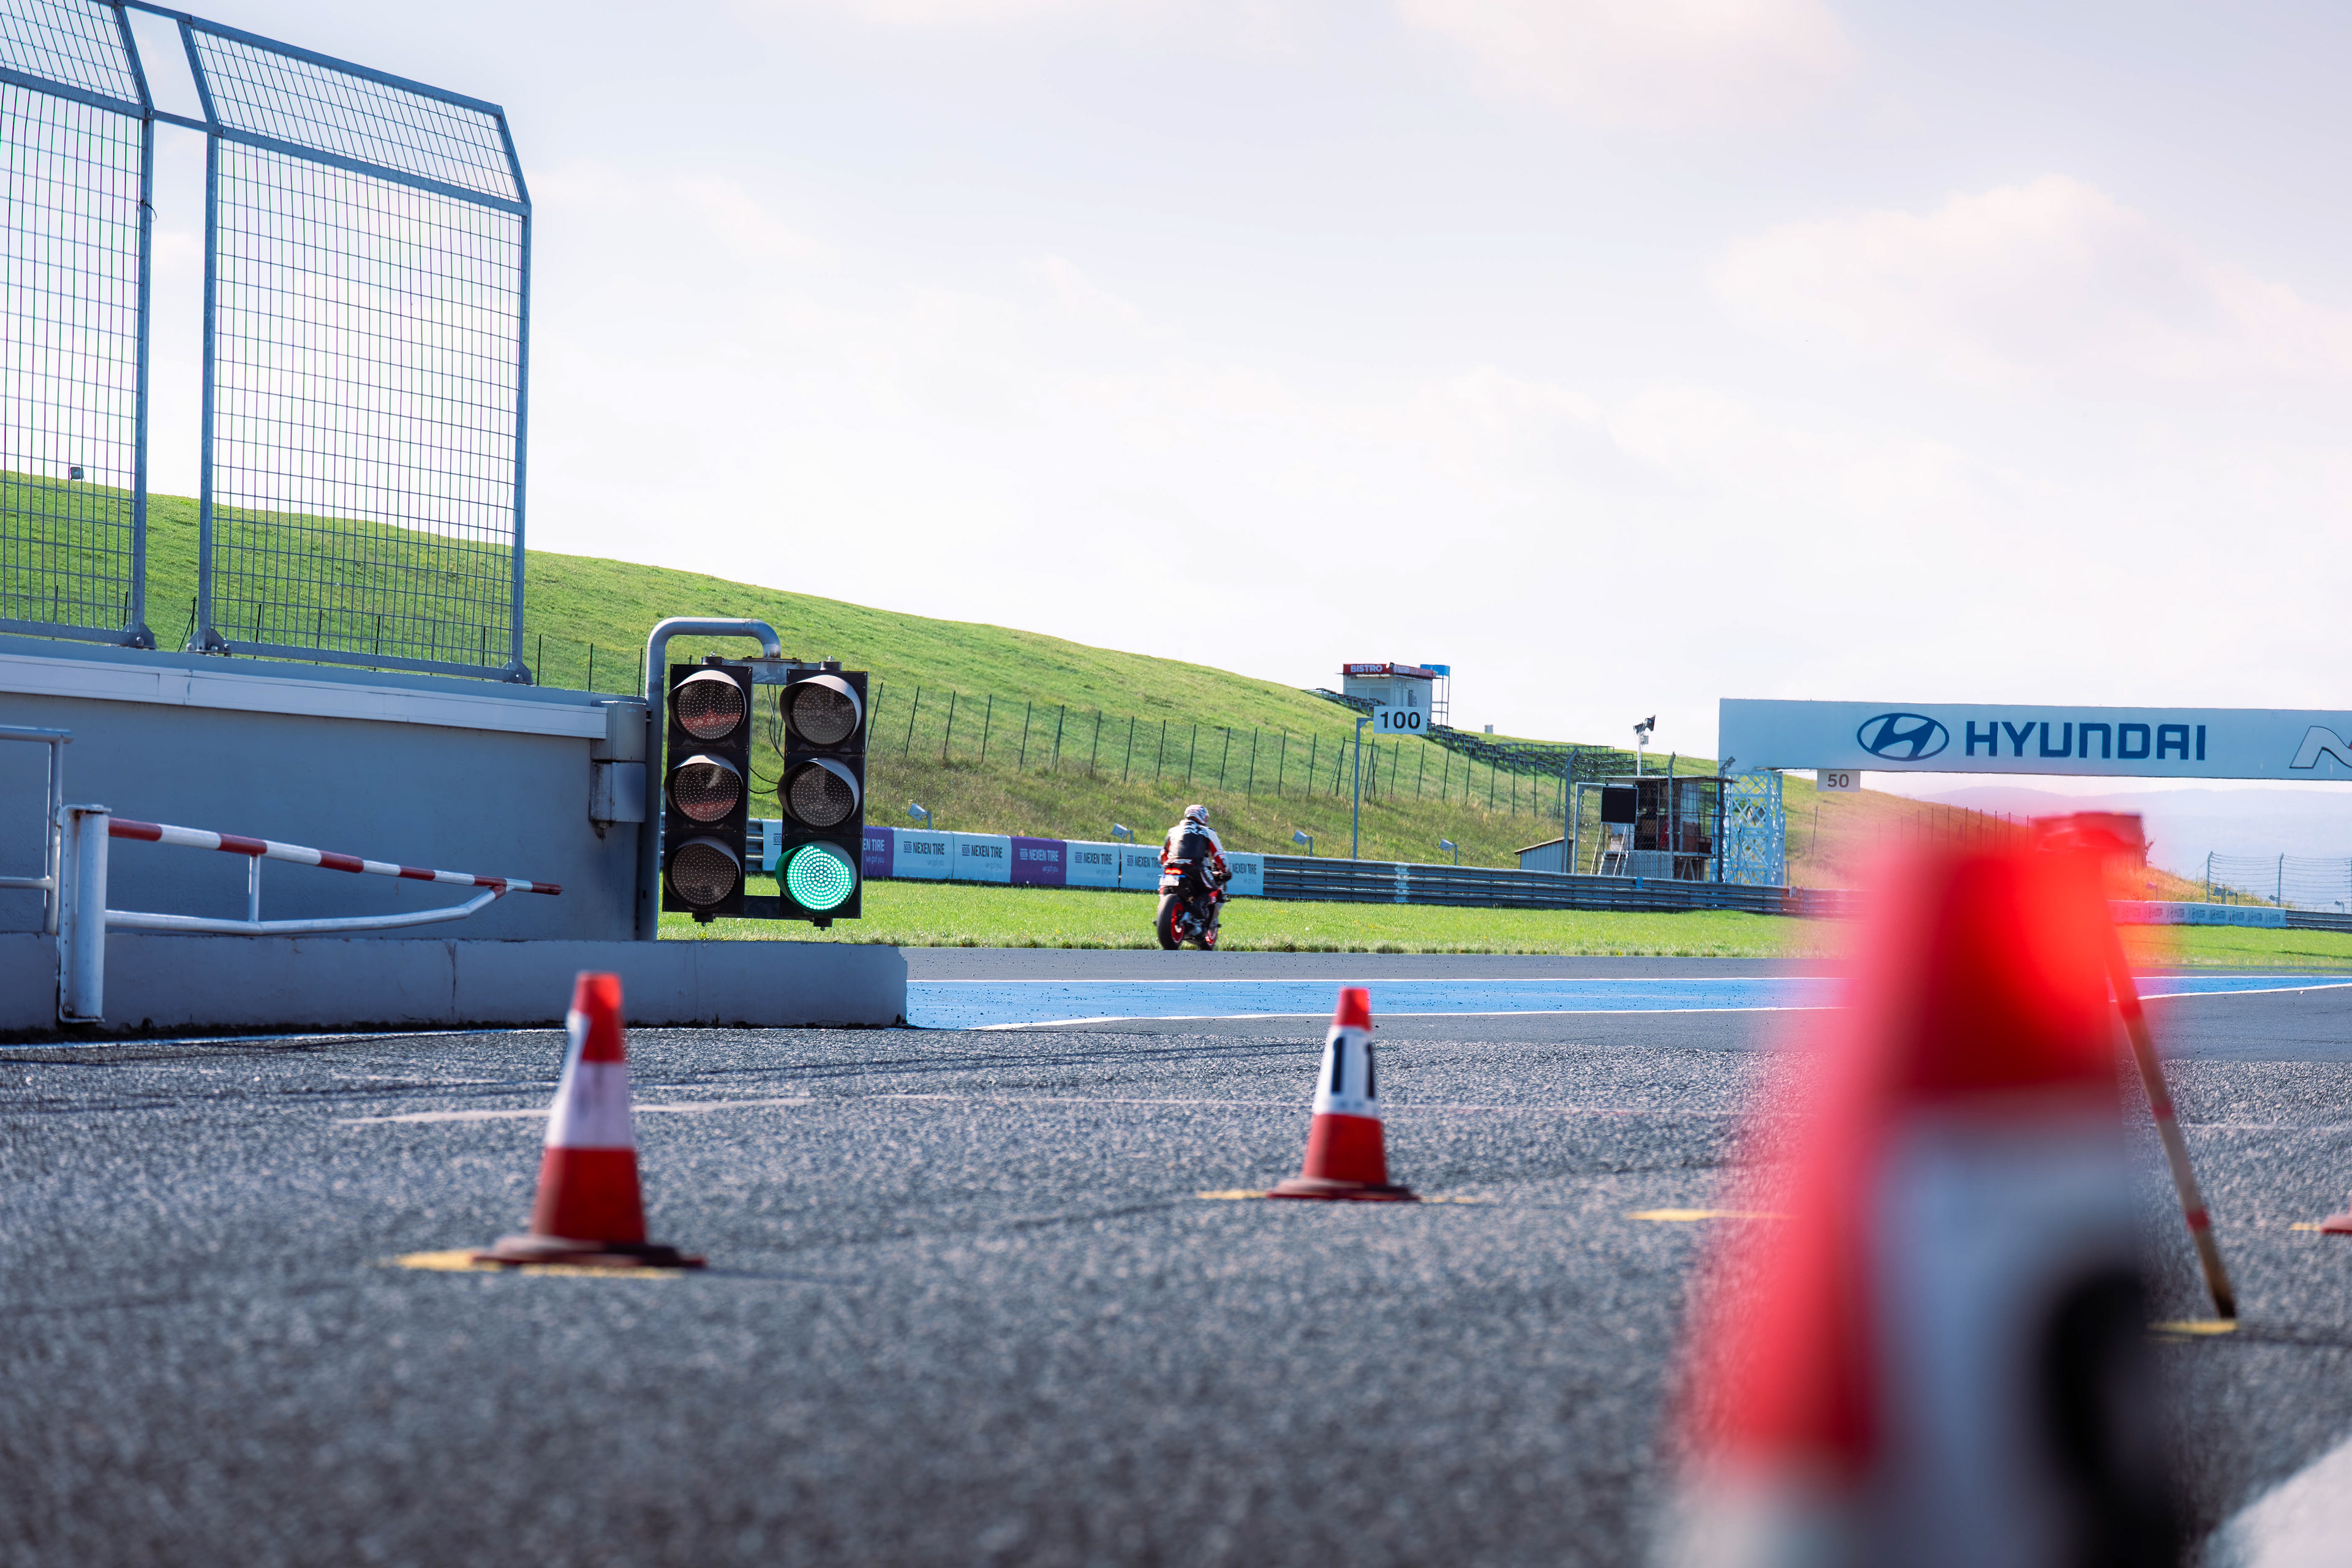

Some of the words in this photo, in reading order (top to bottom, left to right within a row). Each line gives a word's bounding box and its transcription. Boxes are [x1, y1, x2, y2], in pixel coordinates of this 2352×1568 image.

[1380, 711, 1420, 729] 100
[1966, 721, 2206, 761] HYUNDAI
[1827, 774, 1849, 788] 50
[872, 839, 885, 852] TIRE
[913, 842, 931, 854] NEXEN
[932, 843, 945, 855] TIRE
[971, 845, 989, 858] NEXEN
[990, 846, 1003, 858] TIRE
[1029, 849, 1046, 861] NEXEN
[1047, 850, 1059, 862] TIRE
[1084, 853, 1099, 864] NEXEN
[1101, 853, 1112, 865] TIRE
[1134, 856, 1150, 868] NEXEN
